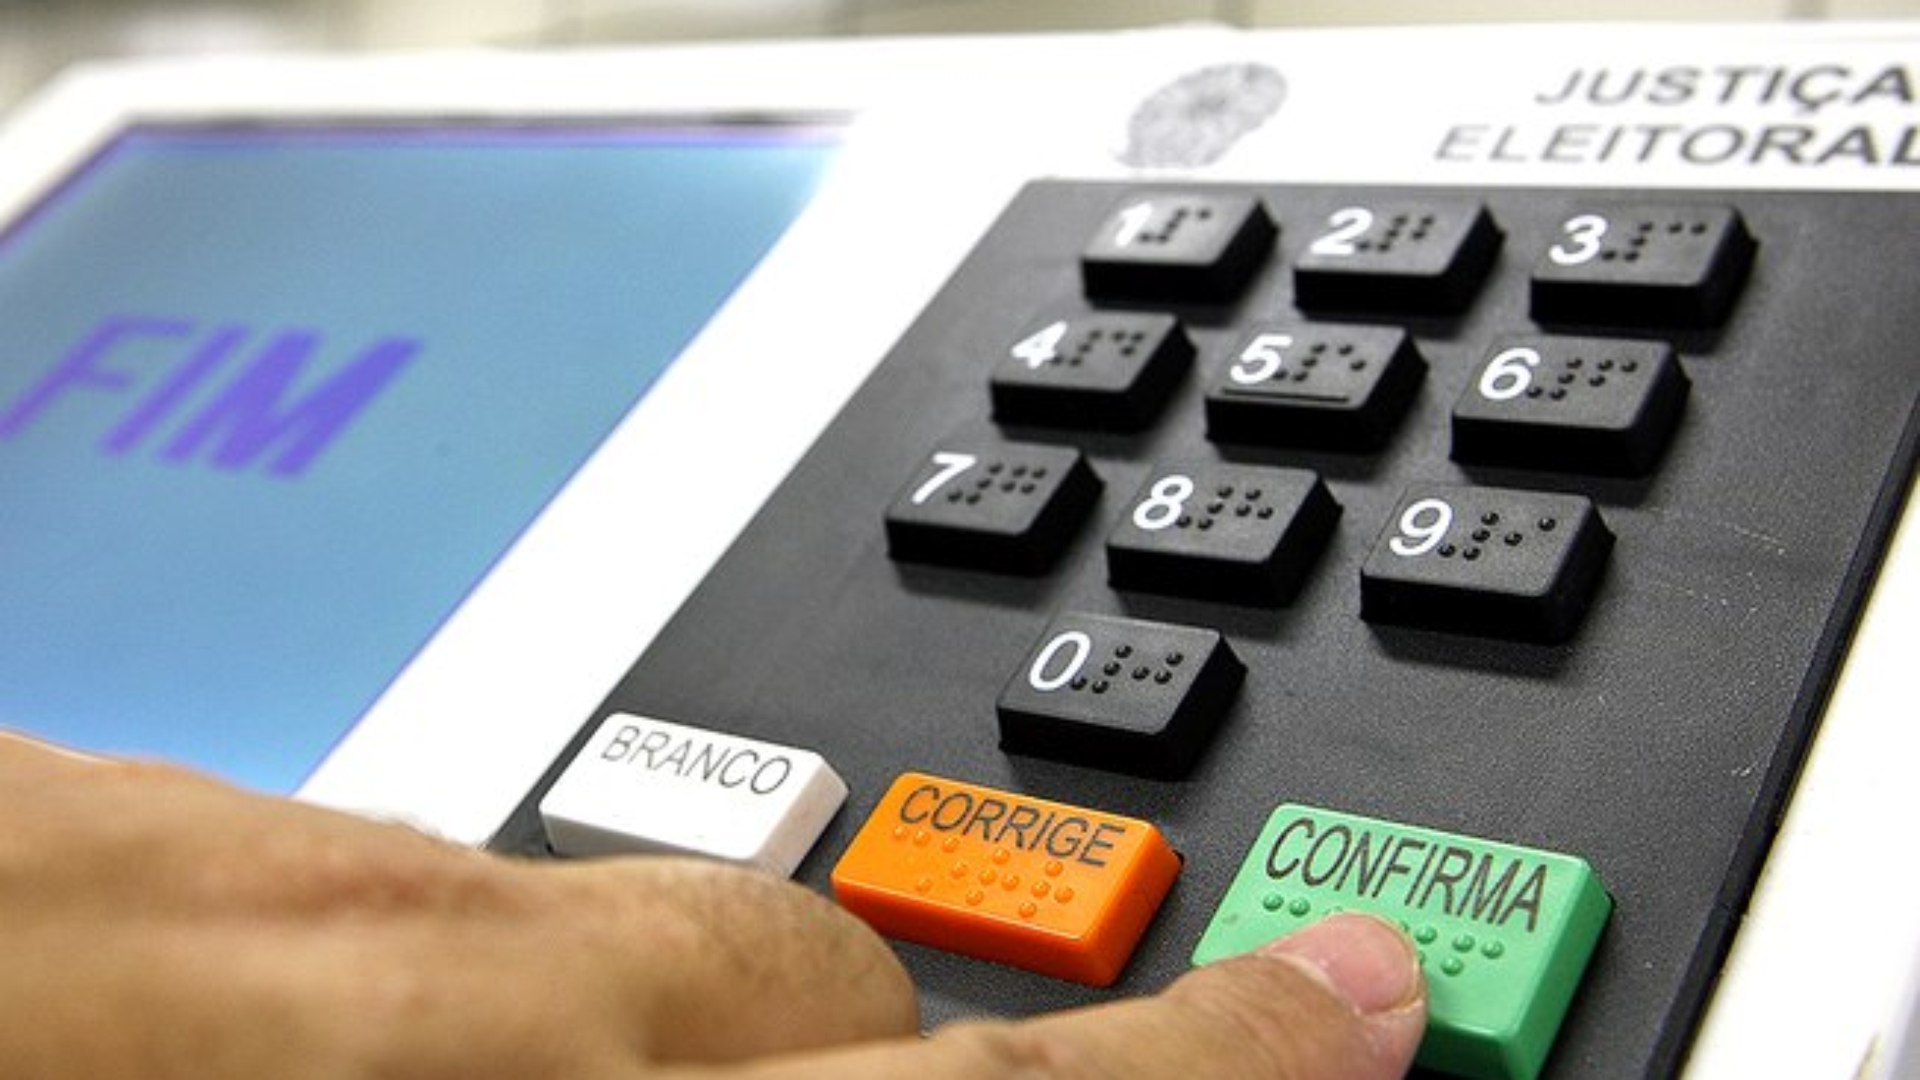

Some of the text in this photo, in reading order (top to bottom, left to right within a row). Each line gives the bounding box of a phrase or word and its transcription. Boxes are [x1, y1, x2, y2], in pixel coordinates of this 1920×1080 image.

[1534, 63, 1915, 114] JUSTIÇA
[1434, 123, 1920, 166] ELEITORAL
[1114, 200, 1155, 248] 1
[1309, 207, 1376, 256] 2
[1548, 214, 1608, 266] 3
[1010, 320, 1068, 370] 4
[1229, 333, 1294, 384] 5
[0, 314, 424, 482] FIM
[1478, 347, 1542, 400] 6
[912, 452, 977, 503] 7
[1132, 474, 1195, 531] 8
[1389, 498, 1454, 557] 9
[1028, 630, 1092, 692] 0
[600, 724, 793, 796] BRANCO
[898, 784, 1126, 868] CORRIGE
[1264, 818, 1549, 933] CONFIRMA
